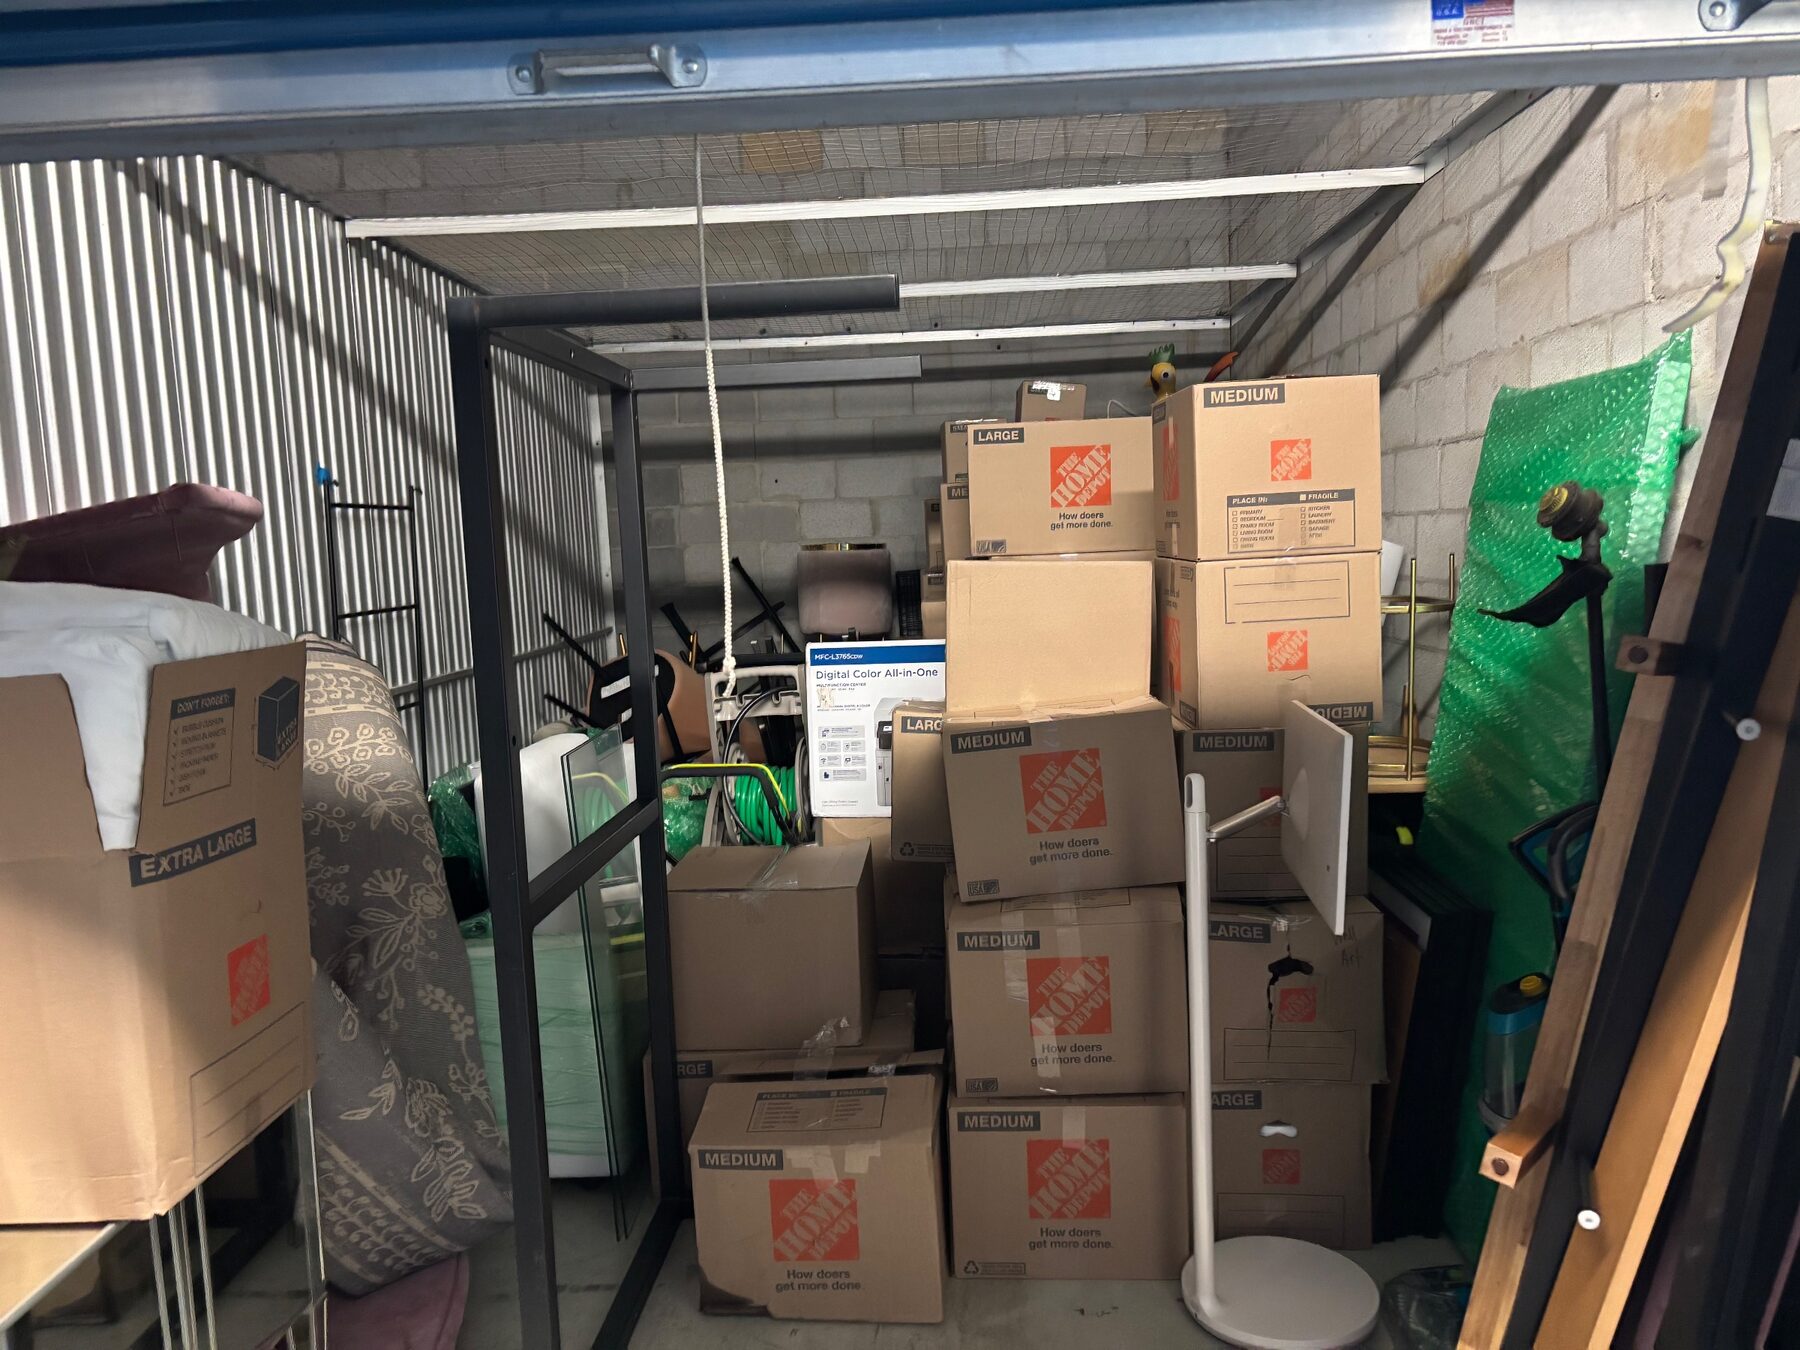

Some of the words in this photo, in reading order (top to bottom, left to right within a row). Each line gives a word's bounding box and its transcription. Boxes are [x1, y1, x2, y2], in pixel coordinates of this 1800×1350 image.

[1210, 387, 1279, 404] MEDIUM
[978, 431, 1019, 442] LARGE
[1056, 451, 1081, 476] THE
[1271, 439, 1312, 481] HOME
[1051, 445, 1111, 508] HOME
[1075, 467, 1111, 506] DEPOT
[1308, 492, 1338, 500] FRAGILE
[1059, 512, 1077, 520] How
[1080, 511, 1104, 519] doers
[1050, 521, 1064, 531] get
[1090, 519, 1113, 528] done.
[816, 670, 850, 680] Digital
[853, 670, 881, 678] Color
[884, 668, 938, 678] All-in-One
[177, 700, 199, 713] DON'T
[1315, 706, 1367, 718] MEDIU
[906, 719, 942, 731] LARG
[957, 731, 1025, 750] MEDIUM
[1200, 736, 1267, 748] MEDIUM
[1031, 761, 1061, 793] THE
[1026, 749, 1101, 833] HOME
[1059, 778, 1103, 830] DEPOT
[140, 844, 203, 878] EXTRA
[207, 825, 252, 857] LARGE
[1040, 839, 1064, 851] How
[1068, 838, 1099, 848] doers
[1029, 855, 1048, 866] get
[1051, 852, 1079, 862] more
[1081, 848, 1113, 859] done.
[964, 934, 1033, 948] MEDIUM
[1036, 966, 1069, 998] THE
[1030, 957, 1110, 1036] HOME
[1062, 986, 1111, 1034] DEPOT
[1042, 1043, 1067, 1054] How
[1070, 1043, 1102, 1053] doers
[1030, 1055, 1049, 1067] get
[1052, 1055, 1081, 1065] more
[1084, 1053, 1116, 1063] done.
[677, 1064, 706, 1075] RGE
[1212, 1094, 1254, 1106] ARGE
[964, 1115, 1034, 1128] MEDIUM
[705, 1152, 776, 1167] MEDIUM
[1036, 1147, 1069, 1179] THE
[1030, 1140, 1110, 1219] HOME
[1062, 1169, 1111, 1218] DEPOT
[783, 1189, 814, 1219] THE
[775, 1181, 855, 1260] HOME
[809, 1209, 857, 1258] DEPOT
[1040, 1227, 1066, 1238] How
[1068, 1227, 1101, 1237] doers
[1029, 1240, 1047, 1251] get
[1050, 1239, 1079, 1249] more
[1083, 1238, 1112, 1248] done.
[787, 1270, 813, 1279] How
[817, 1269, 850, 1279] doers
[776, 1281, 795, 1293] get
[798, 1281, 828, 1290] more
